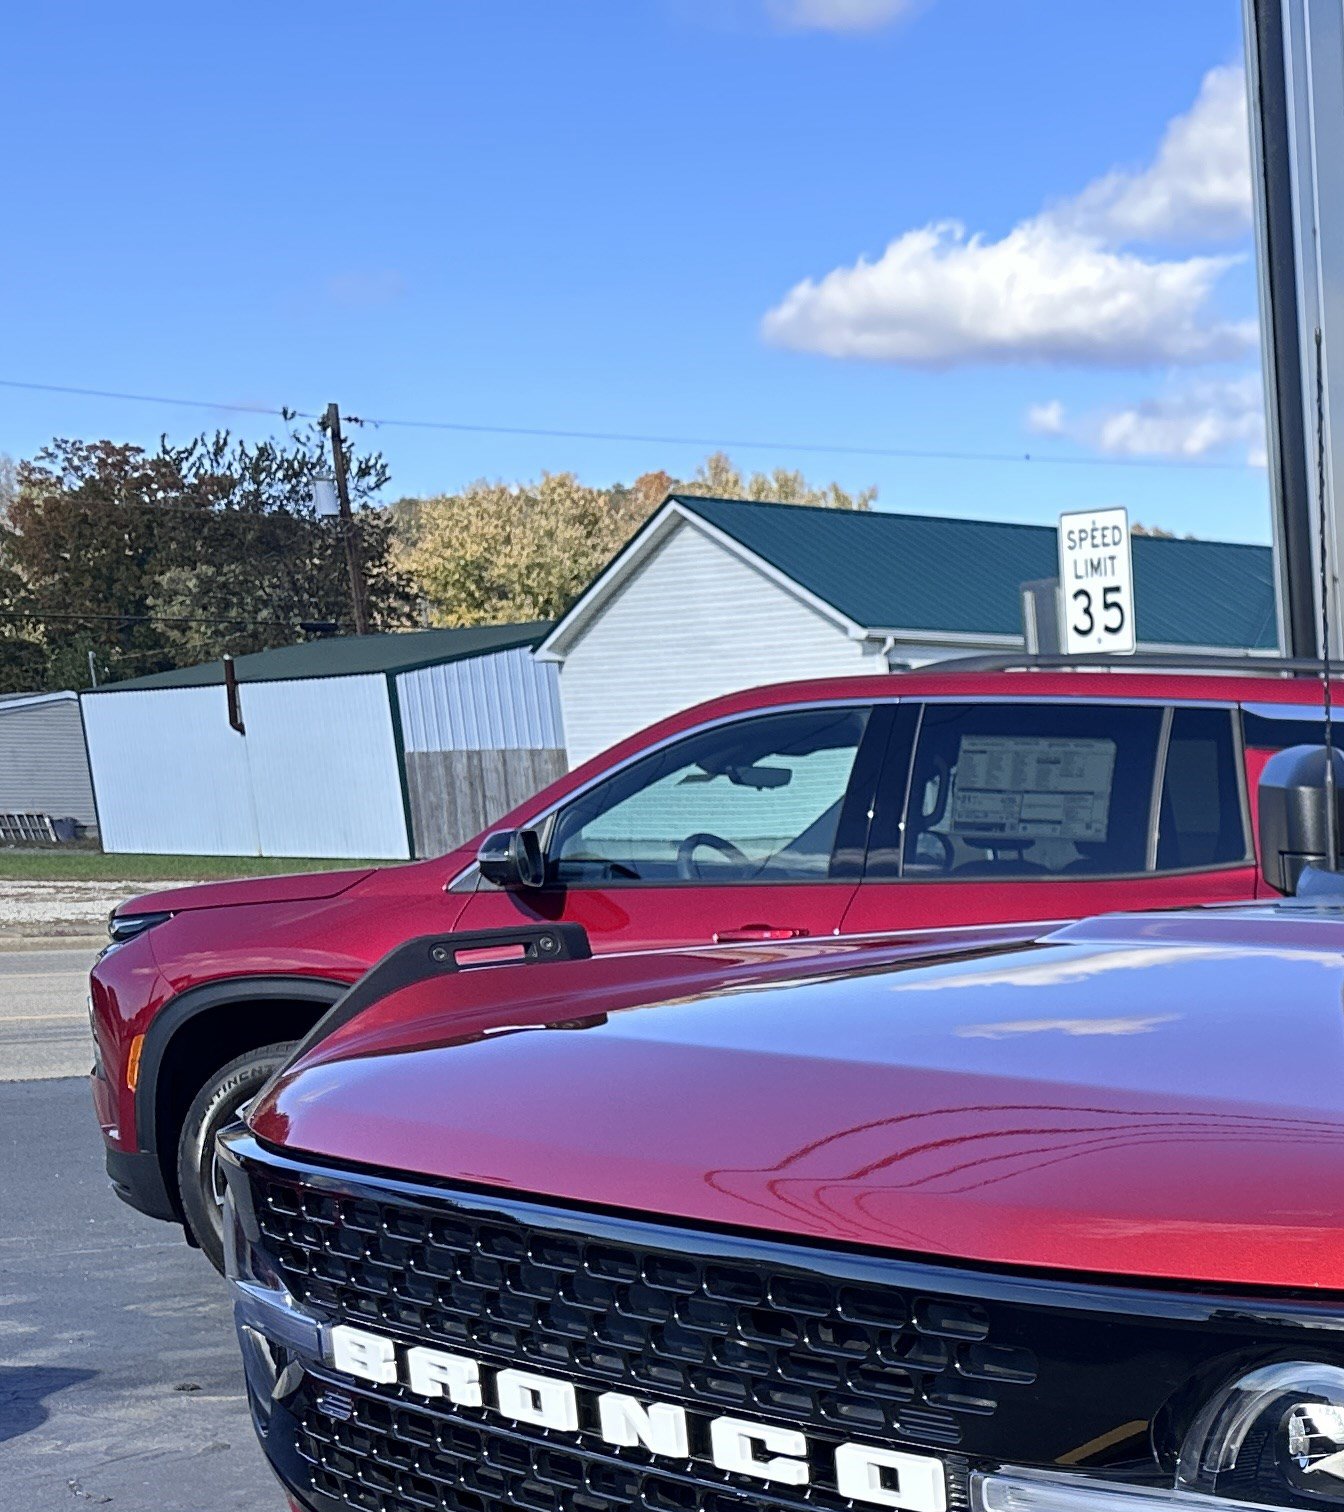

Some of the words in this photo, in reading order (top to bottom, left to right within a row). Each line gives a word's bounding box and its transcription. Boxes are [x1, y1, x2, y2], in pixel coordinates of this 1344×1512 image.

[1067, 525, 1122, 550] SPEED
[1073, 555, 1117, 580] LIMIT
[1072, 585, 1125, 637] 35
